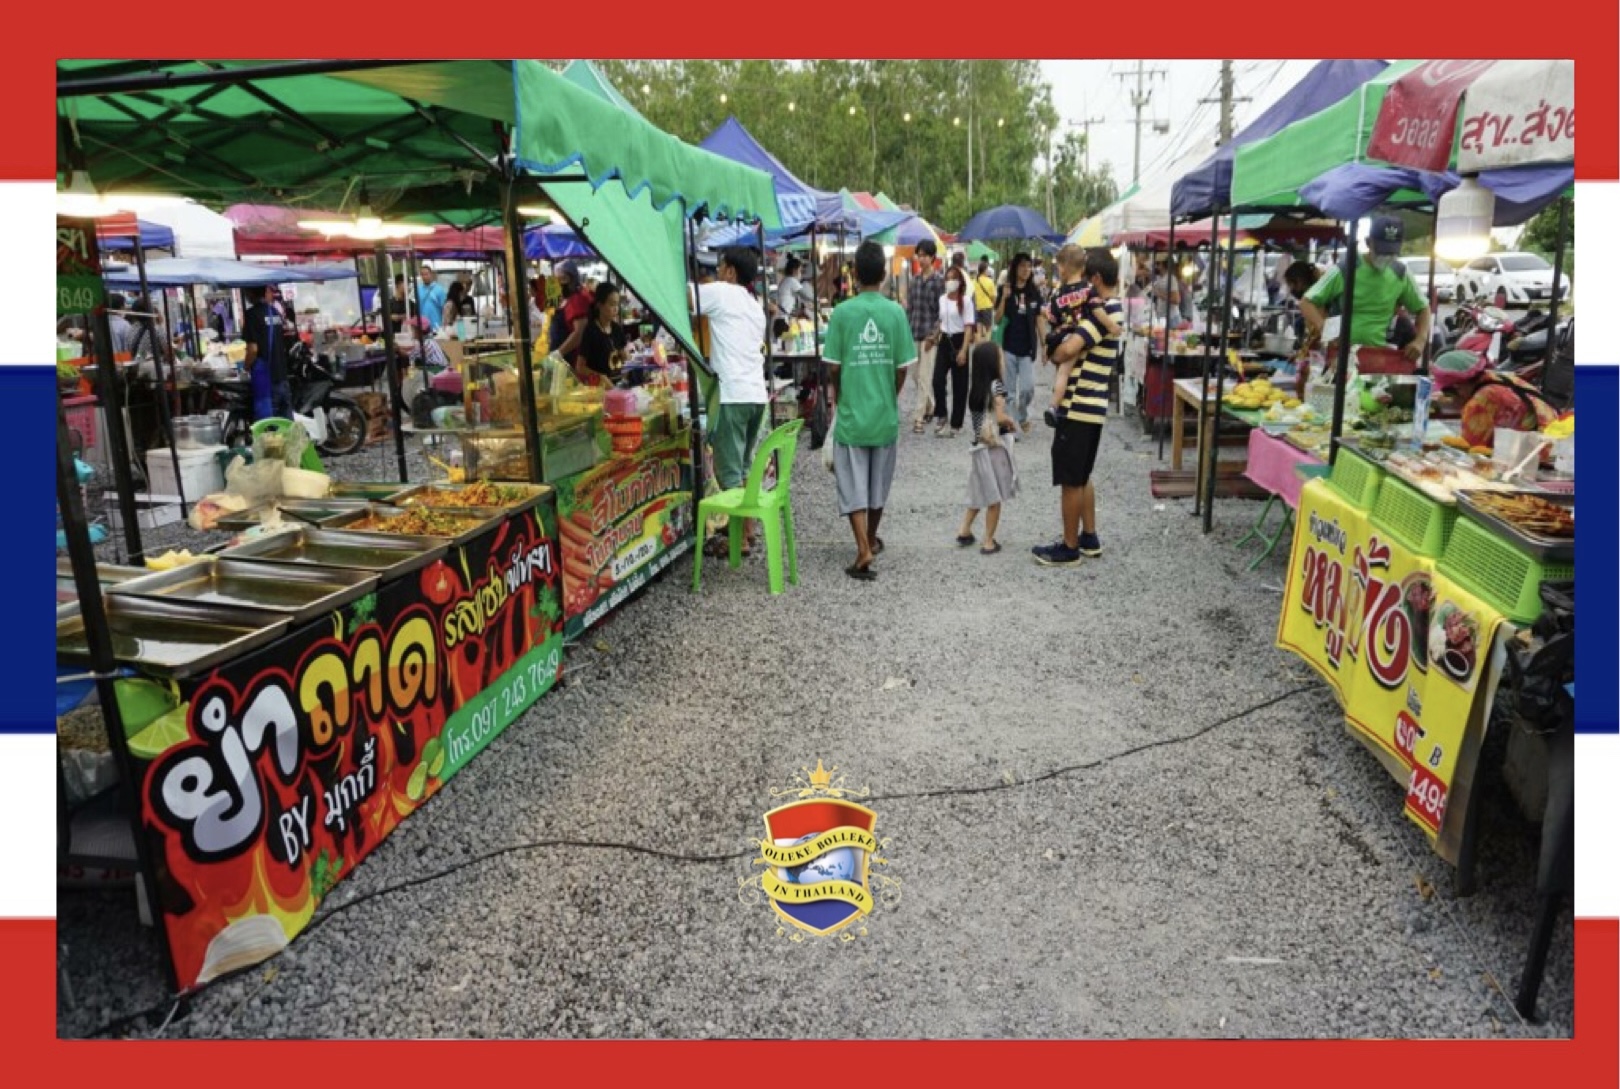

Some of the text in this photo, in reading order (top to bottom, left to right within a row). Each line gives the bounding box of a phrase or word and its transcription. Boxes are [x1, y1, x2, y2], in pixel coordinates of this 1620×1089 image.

[502, 675, 527, 717] 243
[527, 648, 559, 693] 7649
[279, 795, 309, 865] BY
